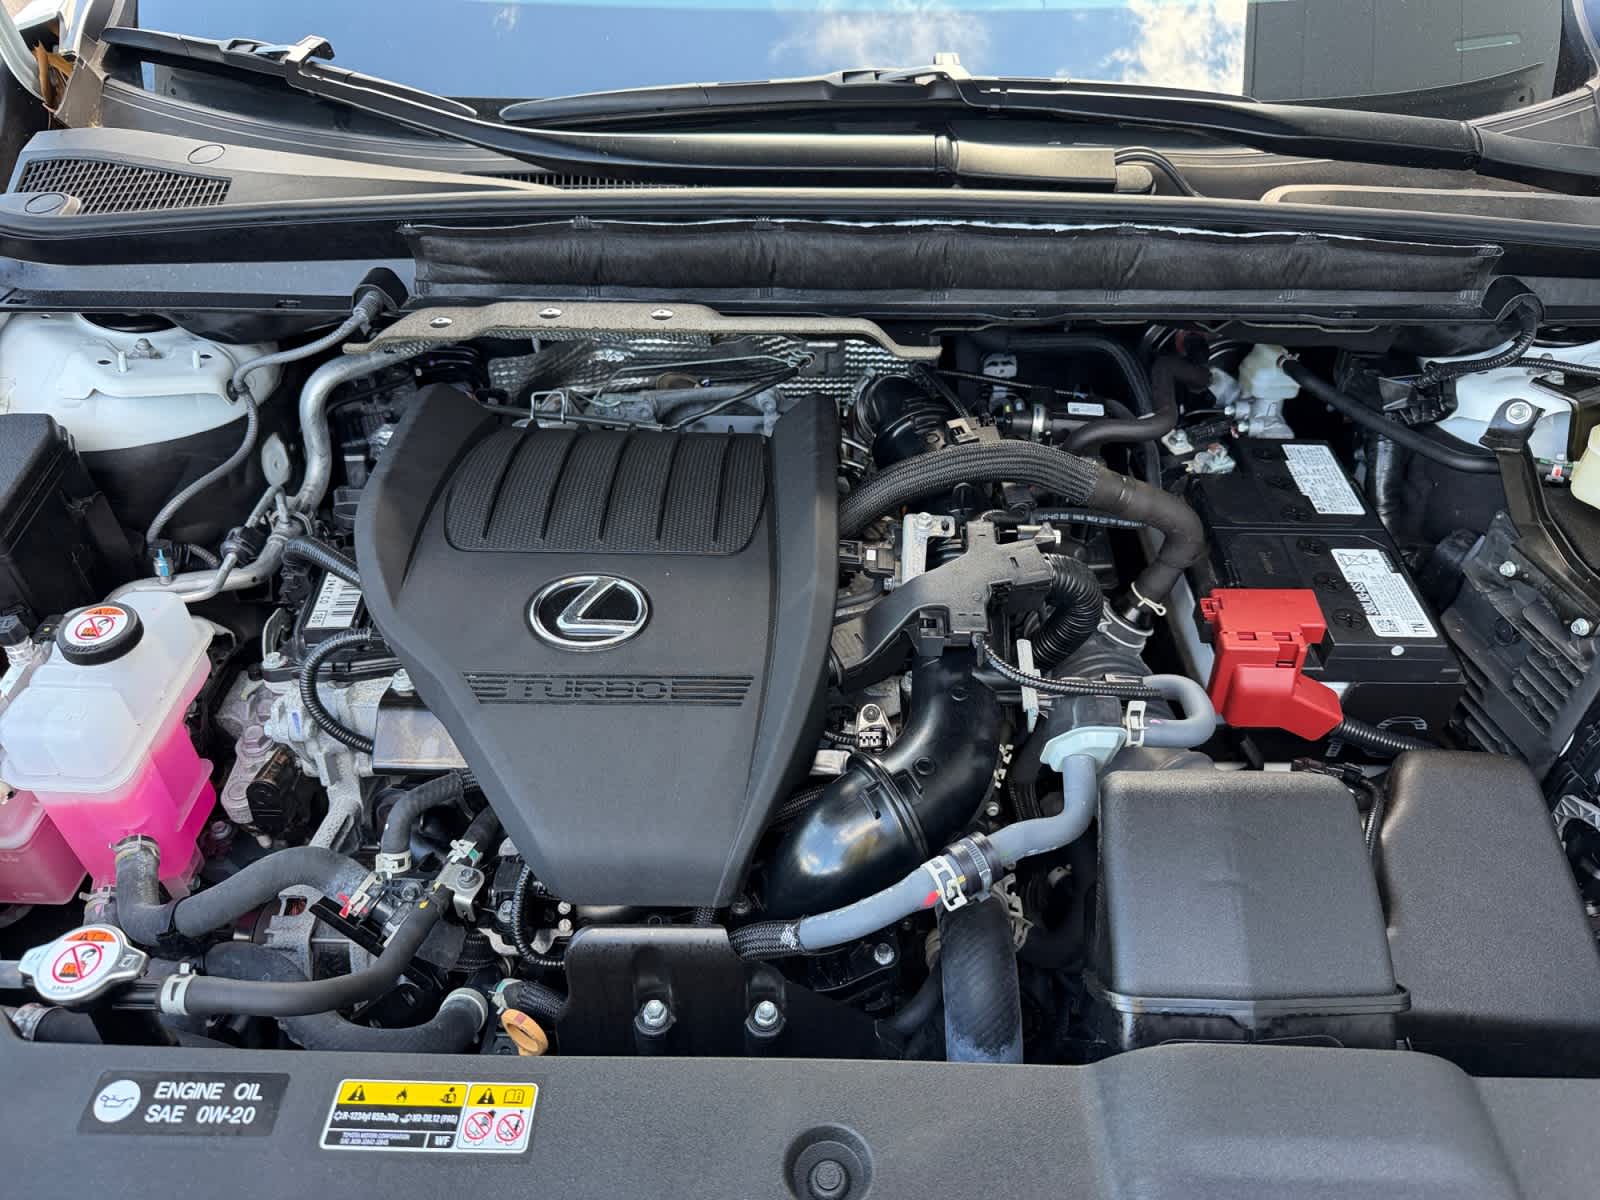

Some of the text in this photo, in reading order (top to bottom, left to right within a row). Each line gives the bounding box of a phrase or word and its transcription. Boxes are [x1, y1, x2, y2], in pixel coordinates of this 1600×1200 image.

[513, 679, 669, 699] TURBO
[153, 1081, 264, 1102] ENGINE OIL
[143, 1104, 257, 1125] SAE 0W-20
